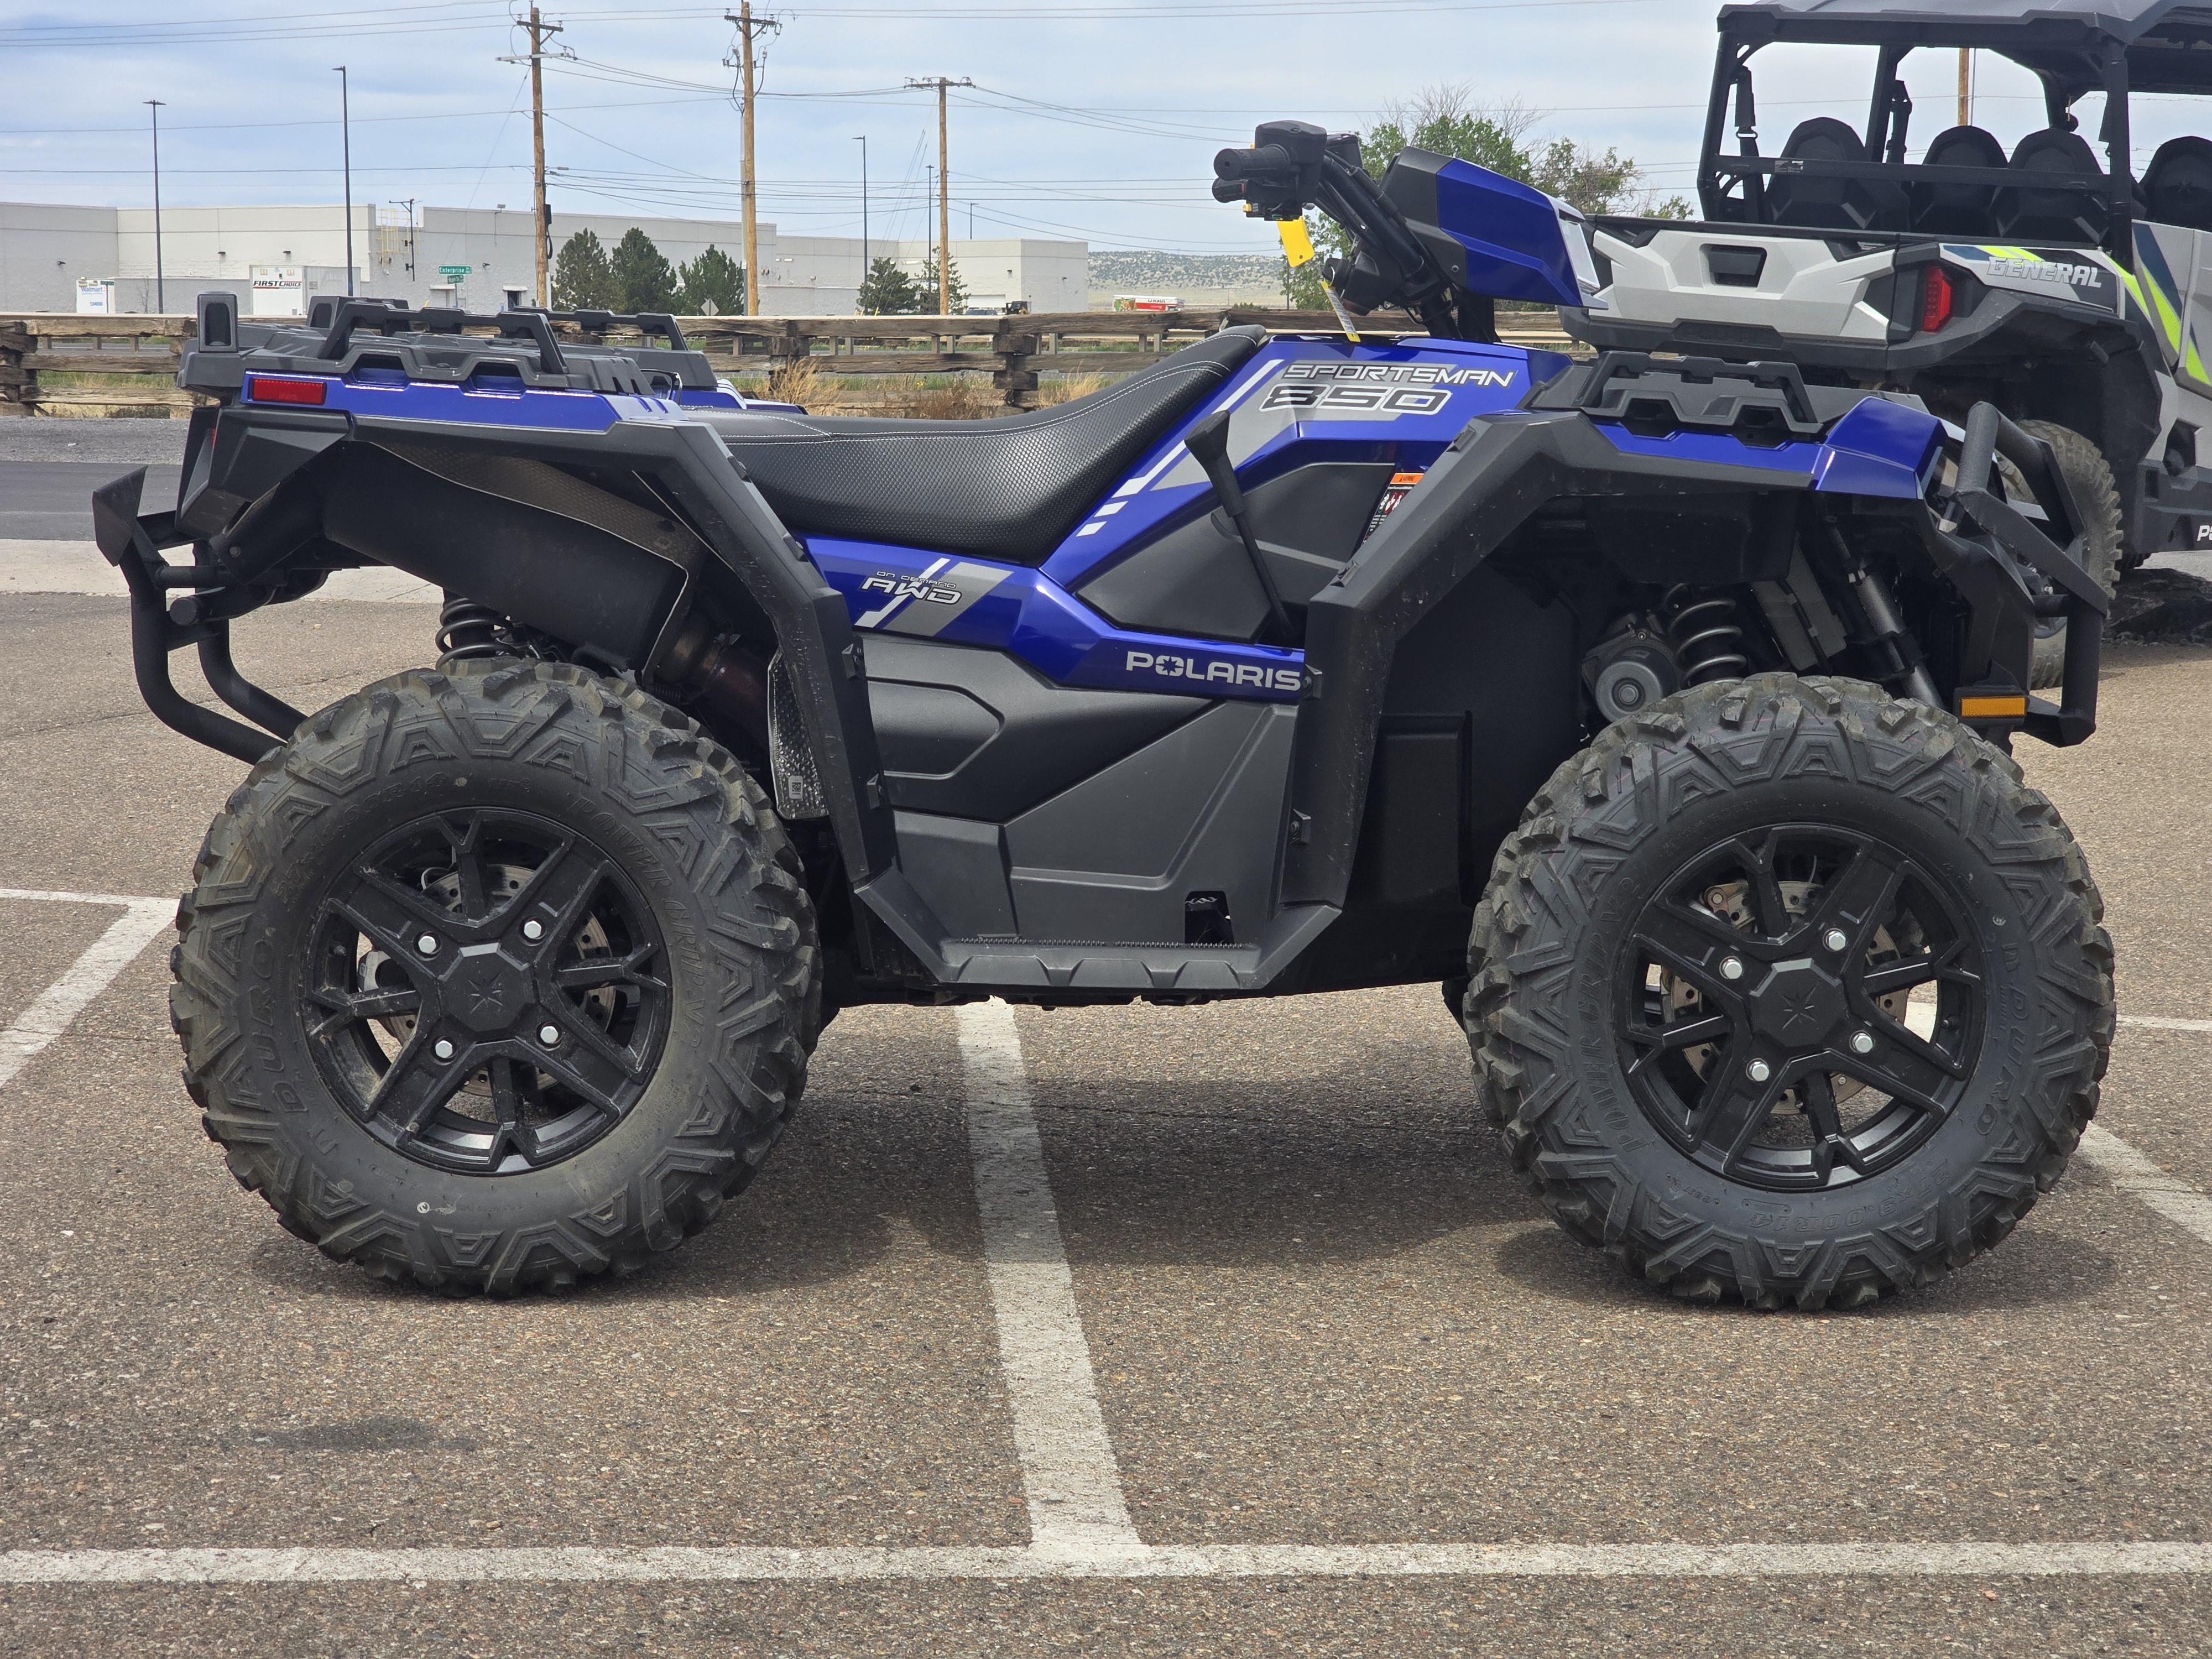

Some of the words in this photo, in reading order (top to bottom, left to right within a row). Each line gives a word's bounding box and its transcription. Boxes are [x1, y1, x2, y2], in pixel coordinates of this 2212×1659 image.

[1986, 256, 2102, 288] GENERAL
[1284, 364, 1515, 388] SPORTSMAN
[1259, 383, 1453, 415] 850
[861, 577, 962, 605] AWD
[900, 576, 956, 588] DEMAND
[1125, 651, 1301, 691] POLARIS
[566, 795, 675, 894] POWER
[249, 938, 306, 1114] DURO
[1972, 985, 2027, 1138] DURO
[1574, 1033, 1648, 1157] POWER
